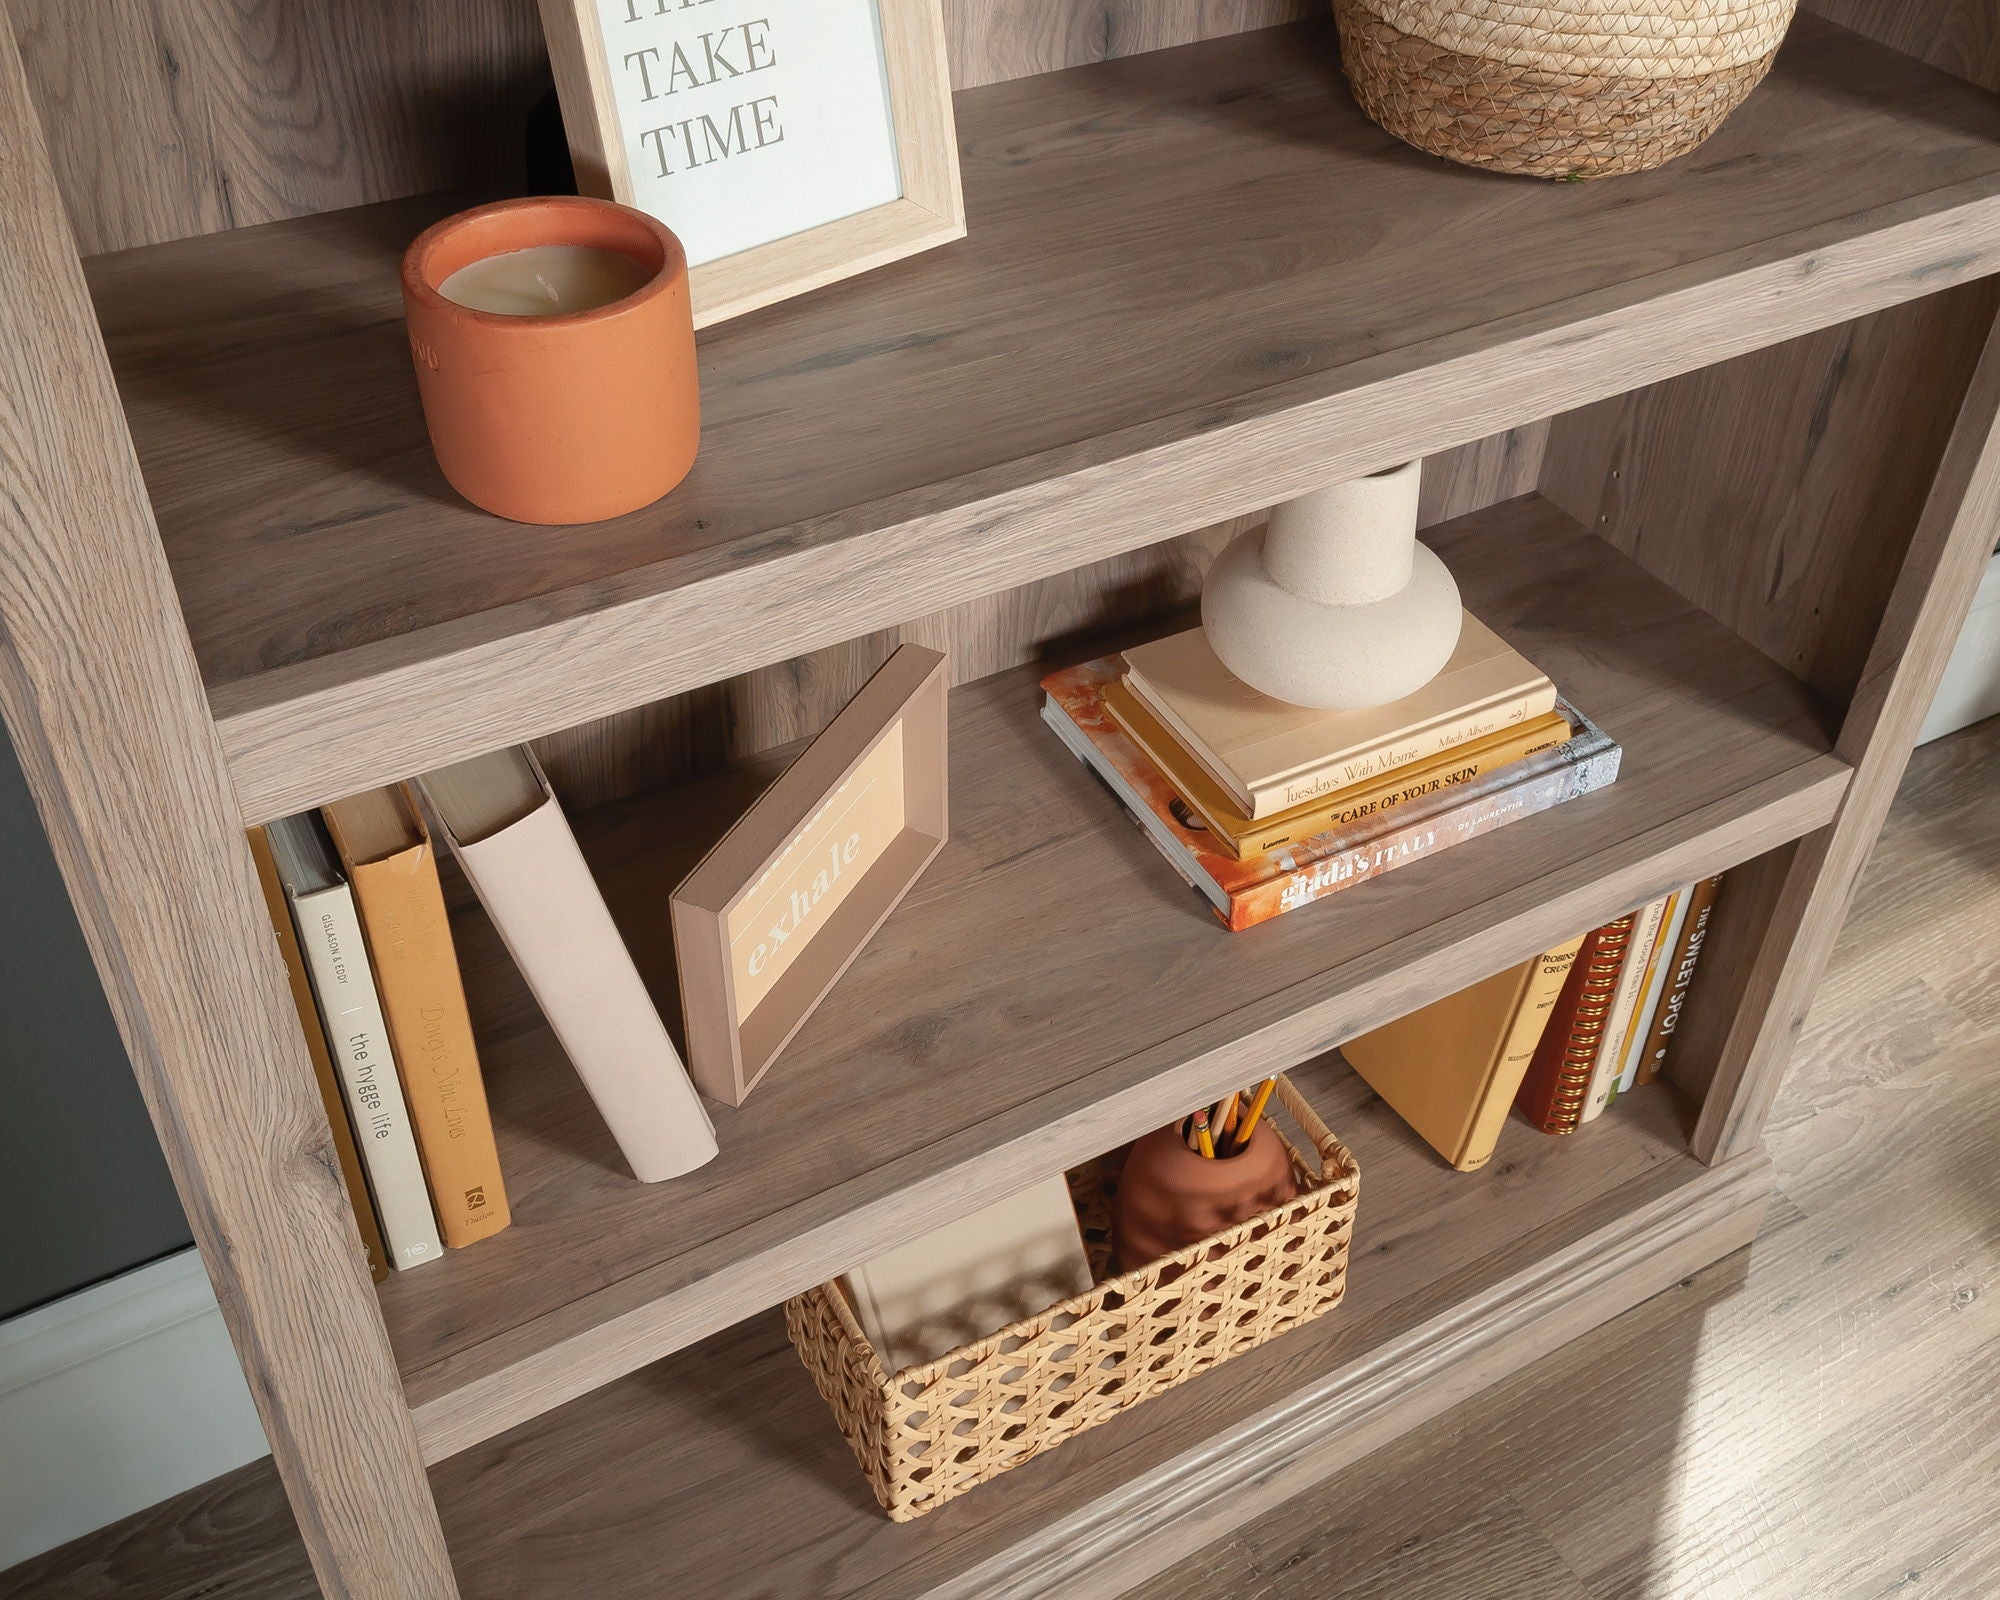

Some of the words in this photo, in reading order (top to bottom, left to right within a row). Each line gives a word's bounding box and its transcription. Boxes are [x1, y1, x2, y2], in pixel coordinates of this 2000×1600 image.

[623, 18, 777, 103] TAKE
[640, 95, 785, 179] TIME
[1438, 731, 1463, 749] Mitch
[1466, 722, 1494, 738] Albom
[1284, 775, 1339, 804] Tuesdays
[1344, 759, 1374, 781] With
[1378, 747, 1419, 771] Morrie
[1341, 801, 1377, 824] CARE
[1381, 794, 1401, 809] OF
[1402, 779, 1440, 801] YOUR
[1444, 765, 1478, 787] SKIN
[1280, 853, 1370, 909] giada's
[1374, 829, 1438, 867] ITALY
[748, 832, 860, 977] exhale
[1696, 905, 1711, 929] THE
[334, 964, 348, 984] EDDY
[1675, 929, 1706, 988] SWEET
[420, 1003, 452, 1062] Dewey's
[1660, 992, 1687, 1035] SPOT
[350, 1033, 369, 1061] the
[356, 1064, 381, 1110] hygge
[432, 1067, 461, 1103] Nine
[371, 1112, 392, 1139] life
[444, 1107, 468, 1139] Lives
